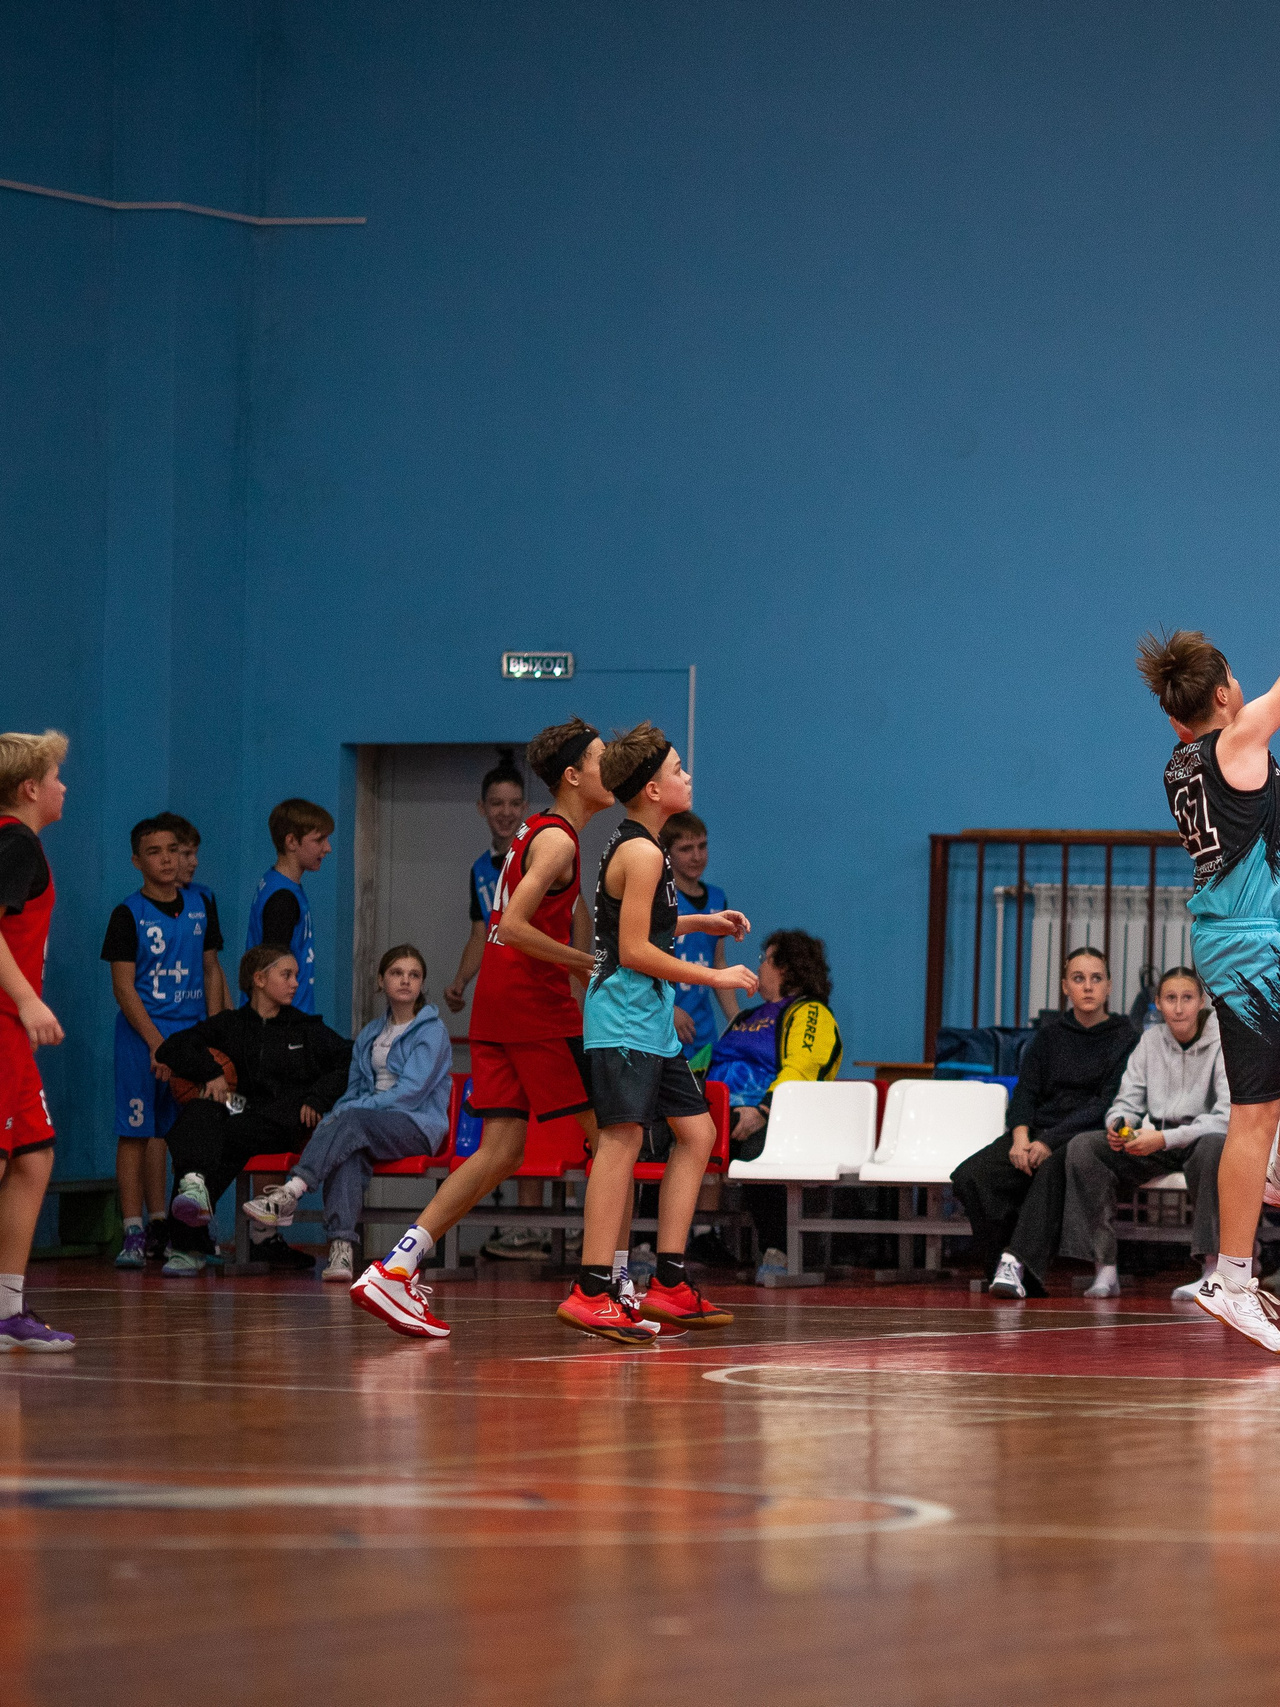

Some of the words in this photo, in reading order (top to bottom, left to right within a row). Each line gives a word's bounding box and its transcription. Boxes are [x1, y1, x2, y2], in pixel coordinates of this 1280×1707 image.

[509, 657, 566, 674] ВЫХОД
[147, 926, 166, 954] 3
[174, 989, 203, 1003] group
[802, 1004, 819, 1053] TERREX
[129, 1098, 144, 1127] 3
